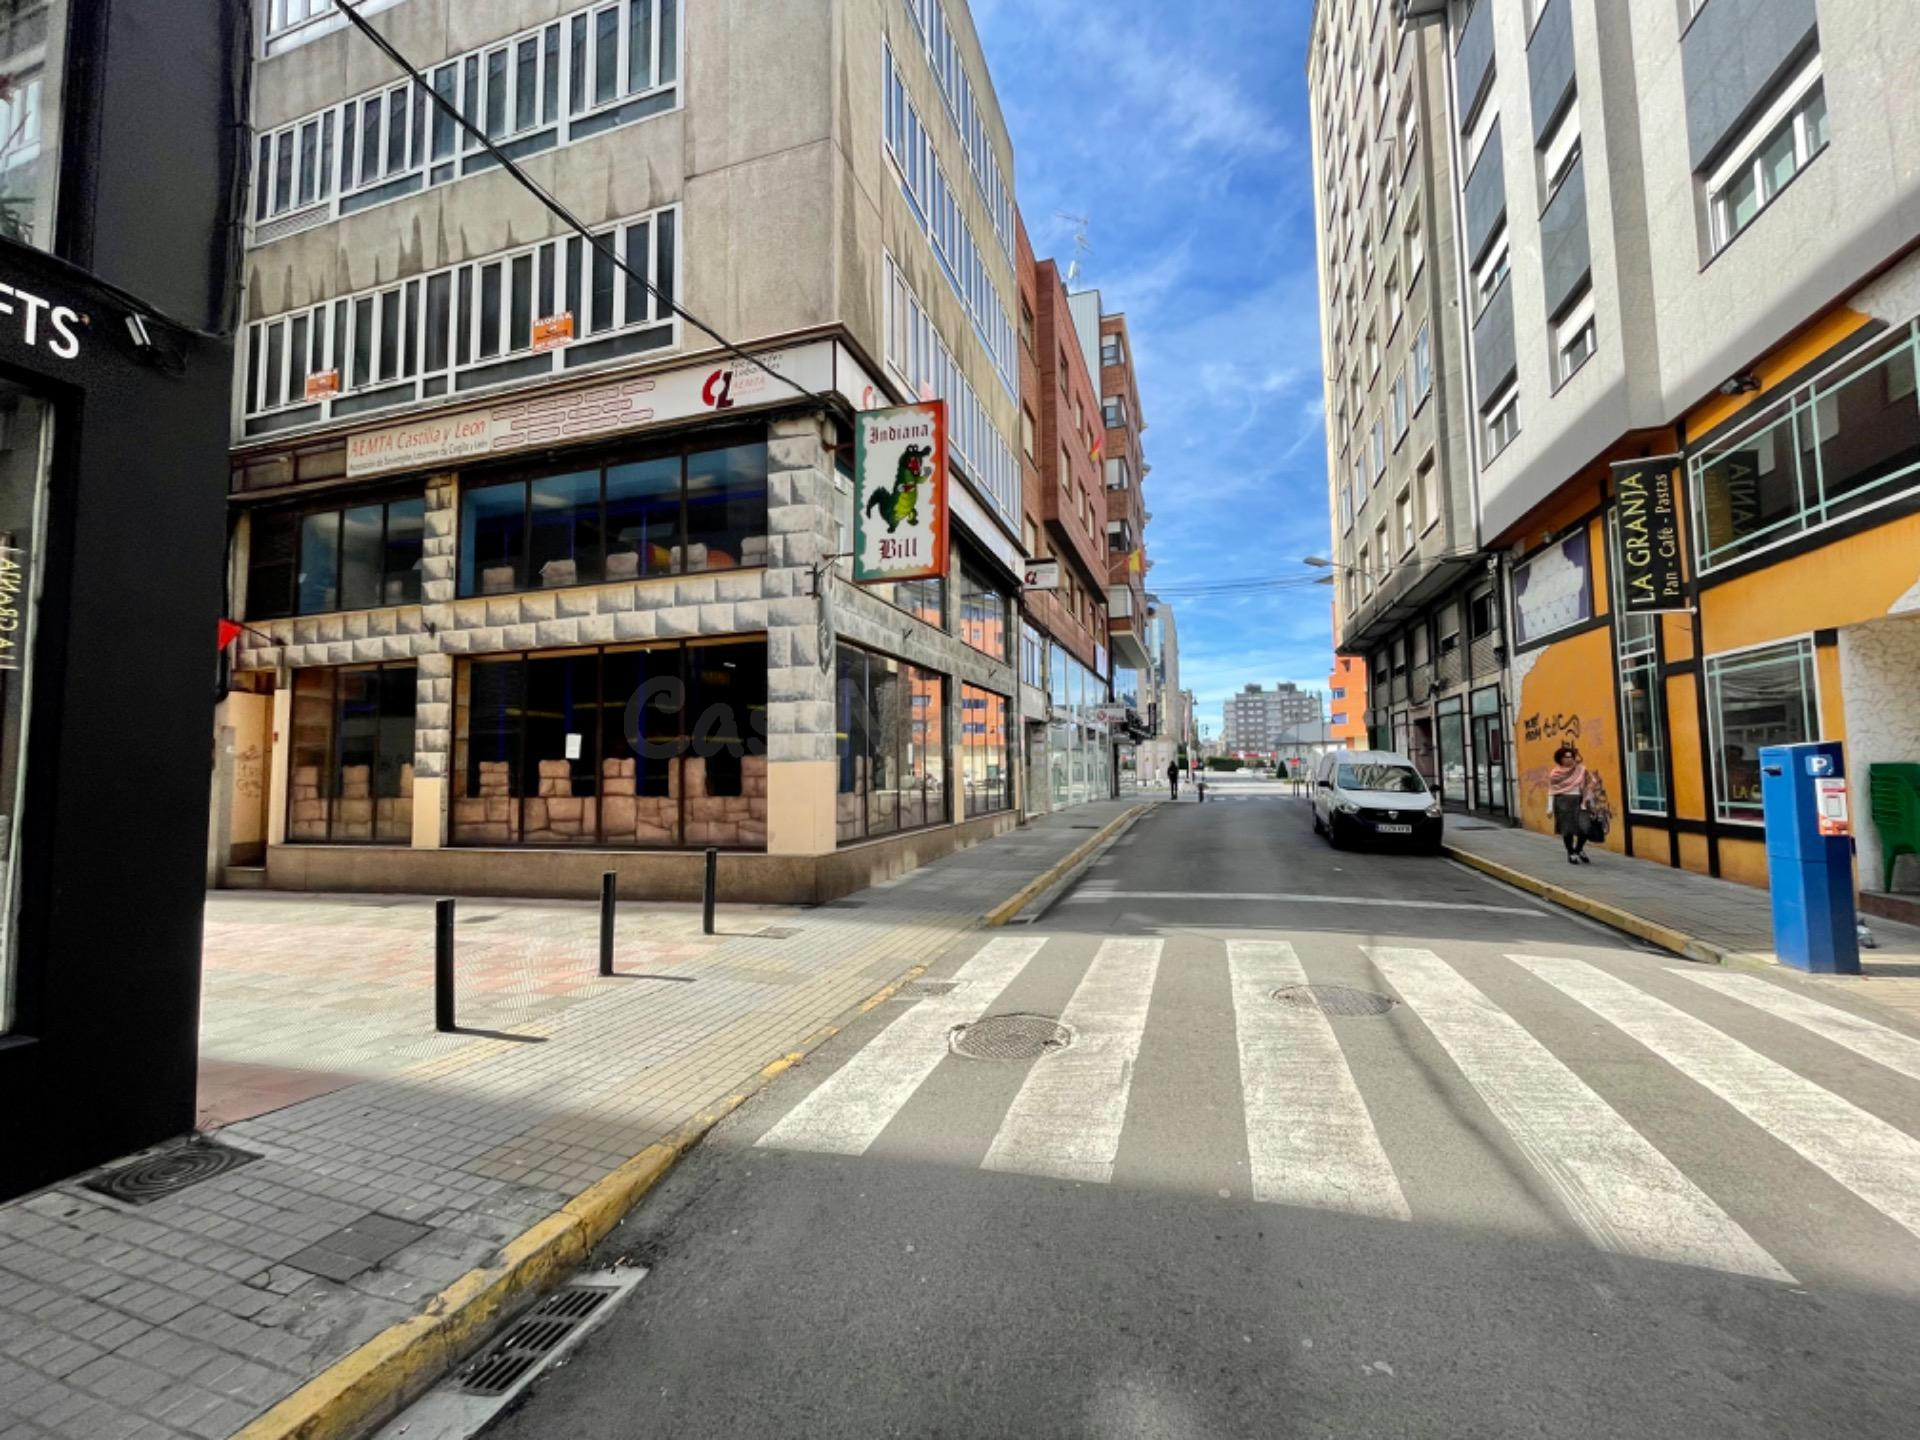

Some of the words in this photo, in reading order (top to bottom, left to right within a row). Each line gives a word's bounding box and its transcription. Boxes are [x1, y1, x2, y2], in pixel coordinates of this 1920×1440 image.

[397, 426, 440, 449] Castilla
[869, 423, 929, 444] Indiana
[1655, 473, 1671, 514] Pastas
[1619, 472, 1651, 567] GRANJA
[878, 537, 918, 562] Bill
[1631, 572, 1656, 604] LA
[1663, 571, 1679, 597] Pan
[1811, 757, 1828, 773] P
